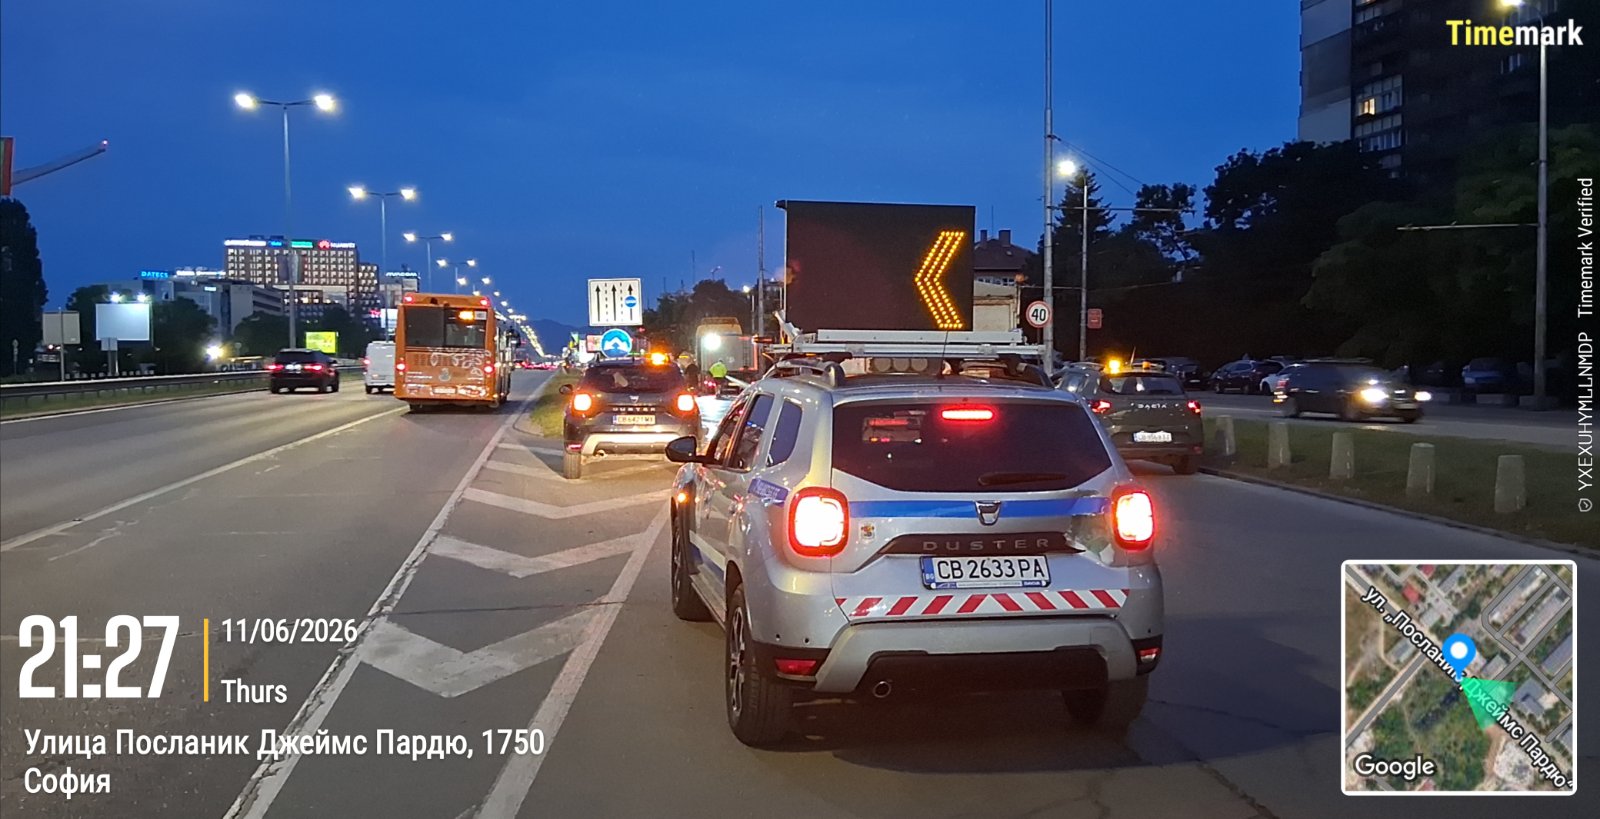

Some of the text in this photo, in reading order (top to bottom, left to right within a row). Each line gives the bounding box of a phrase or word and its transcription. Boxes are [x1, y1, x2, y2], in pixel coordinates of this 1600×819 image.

[1031, 308, 1047, 322] 40
[923, 539, 1049, 551] DUSTER
[967, 559, 1016, 579] 2633
